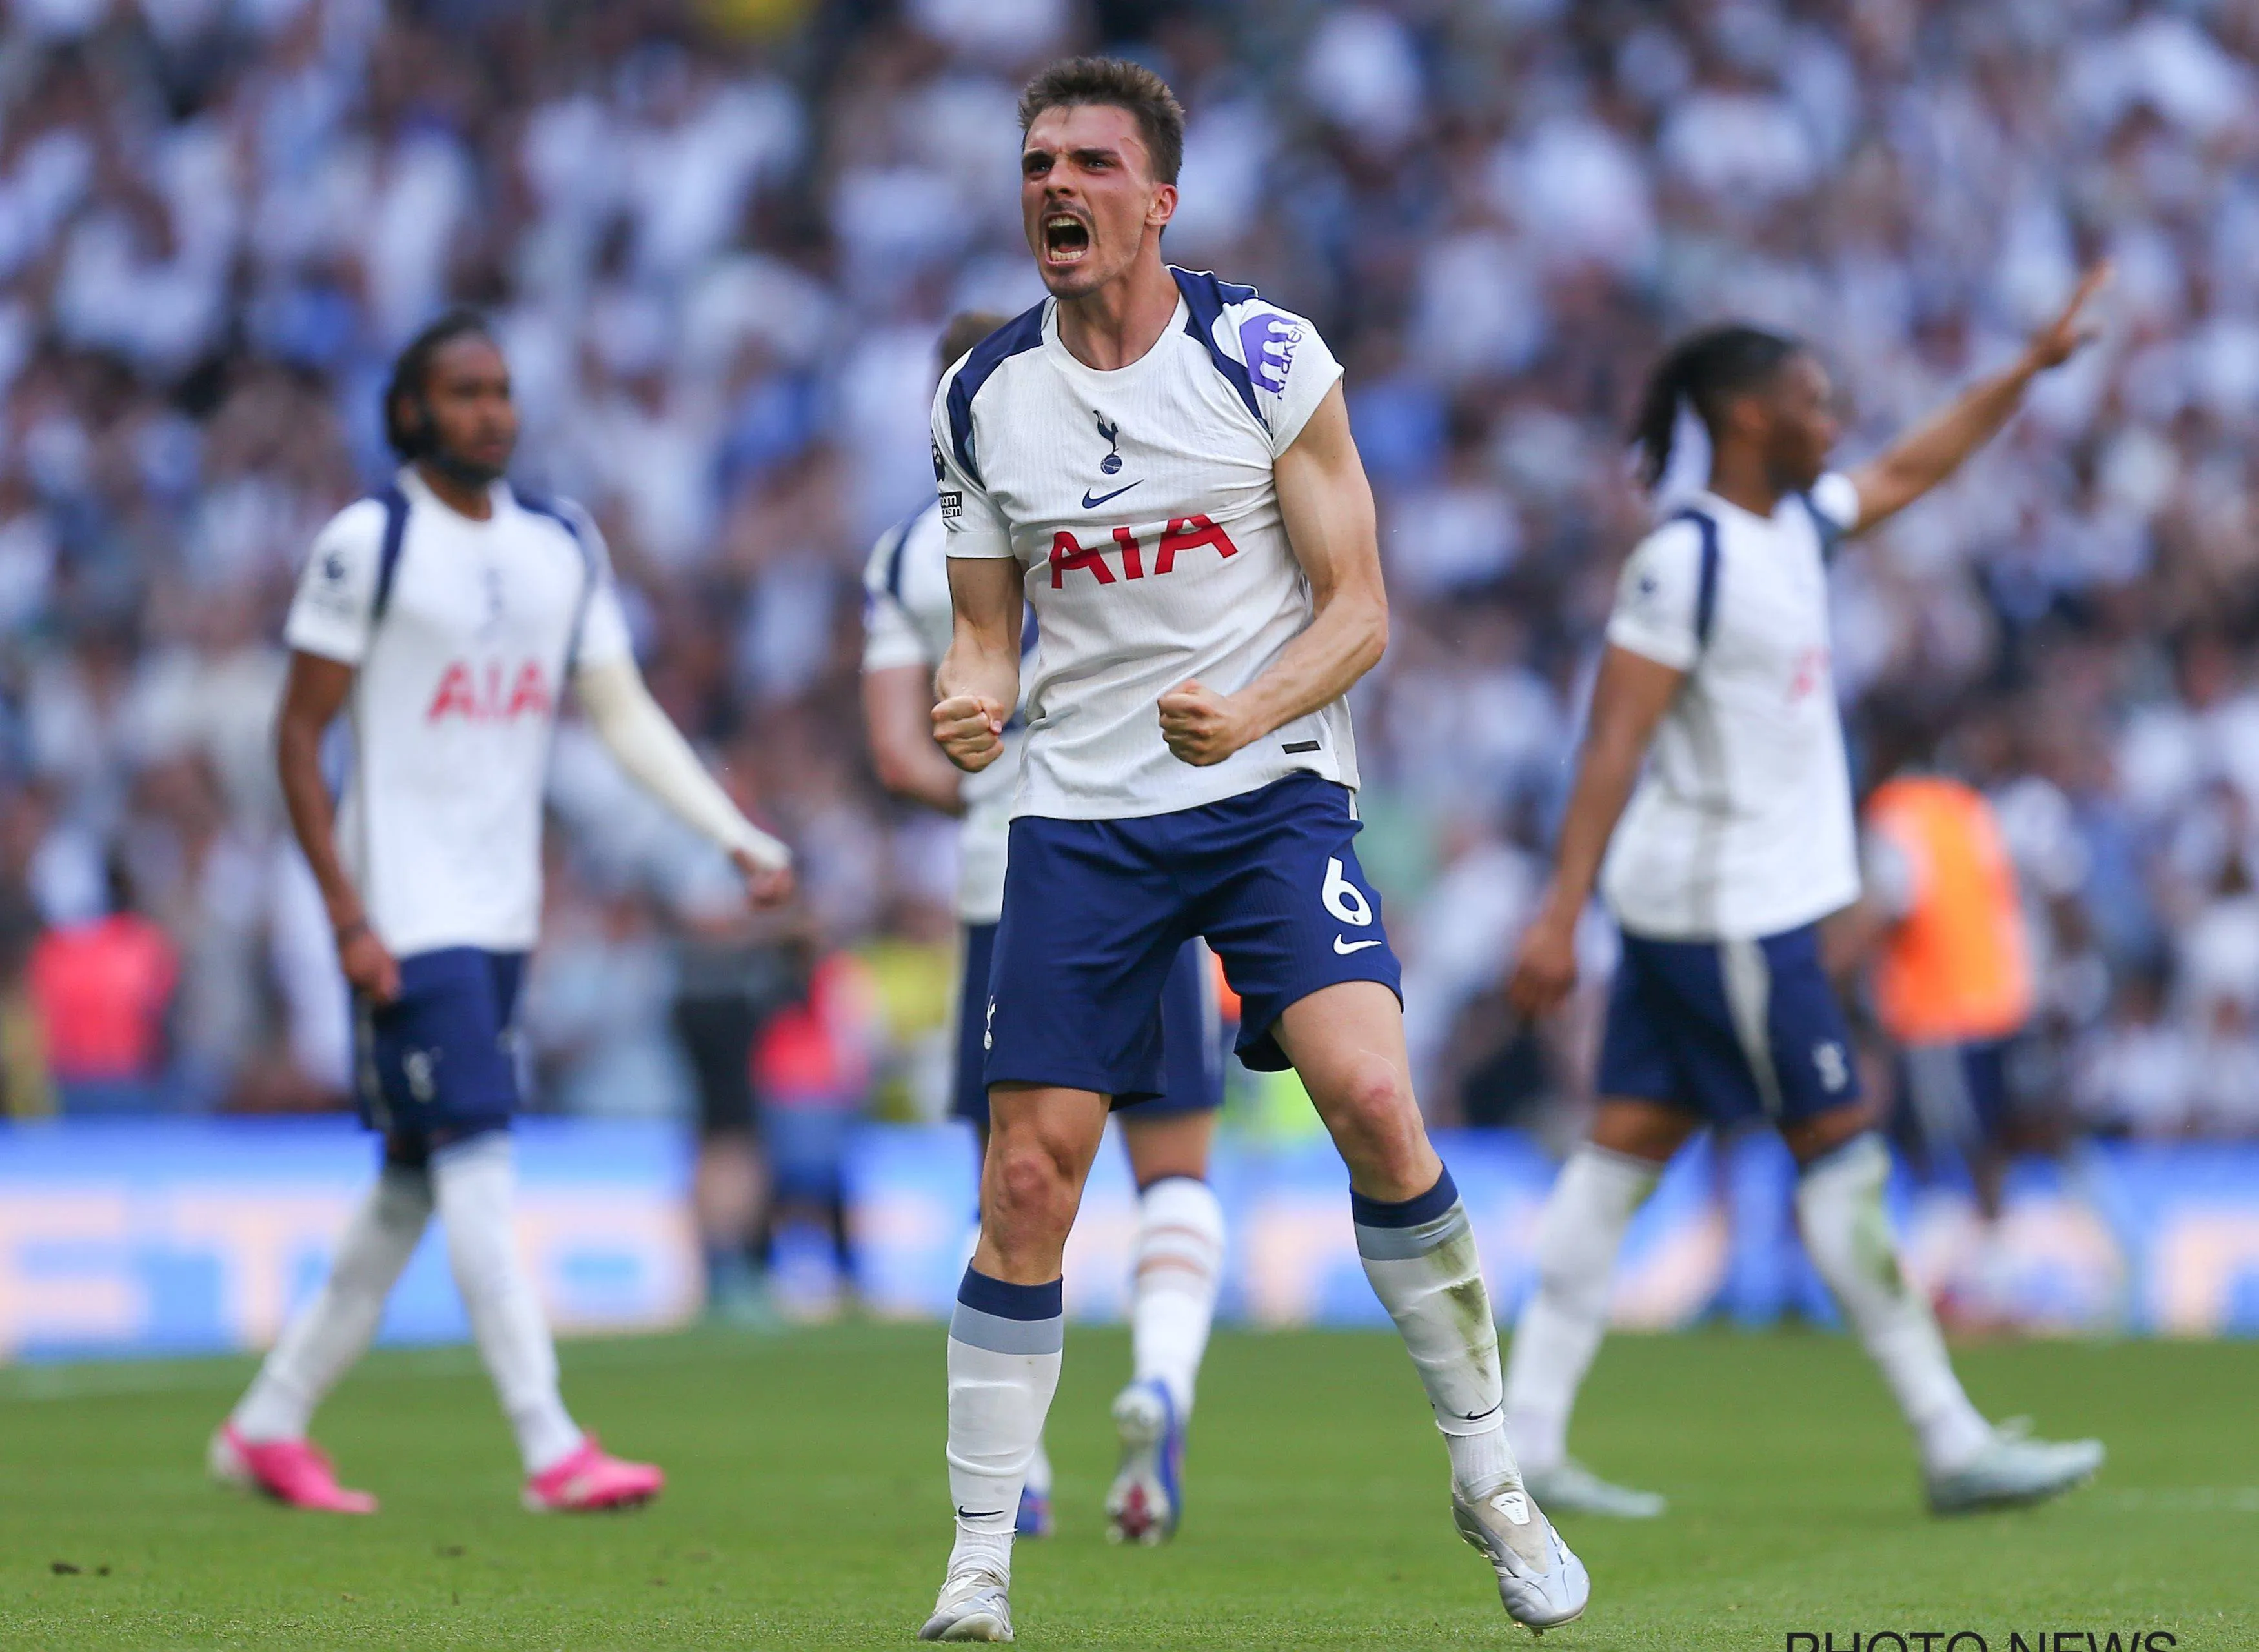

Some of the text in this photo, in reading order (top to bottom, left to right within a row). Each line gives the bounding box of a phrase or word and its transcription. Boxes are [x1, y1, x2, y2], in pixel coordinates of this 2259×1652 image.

[1049, 514, 1238, 589] AIA
[427, 660, 553, 725] AIA
[1322, 856, 1373, 926] 6
